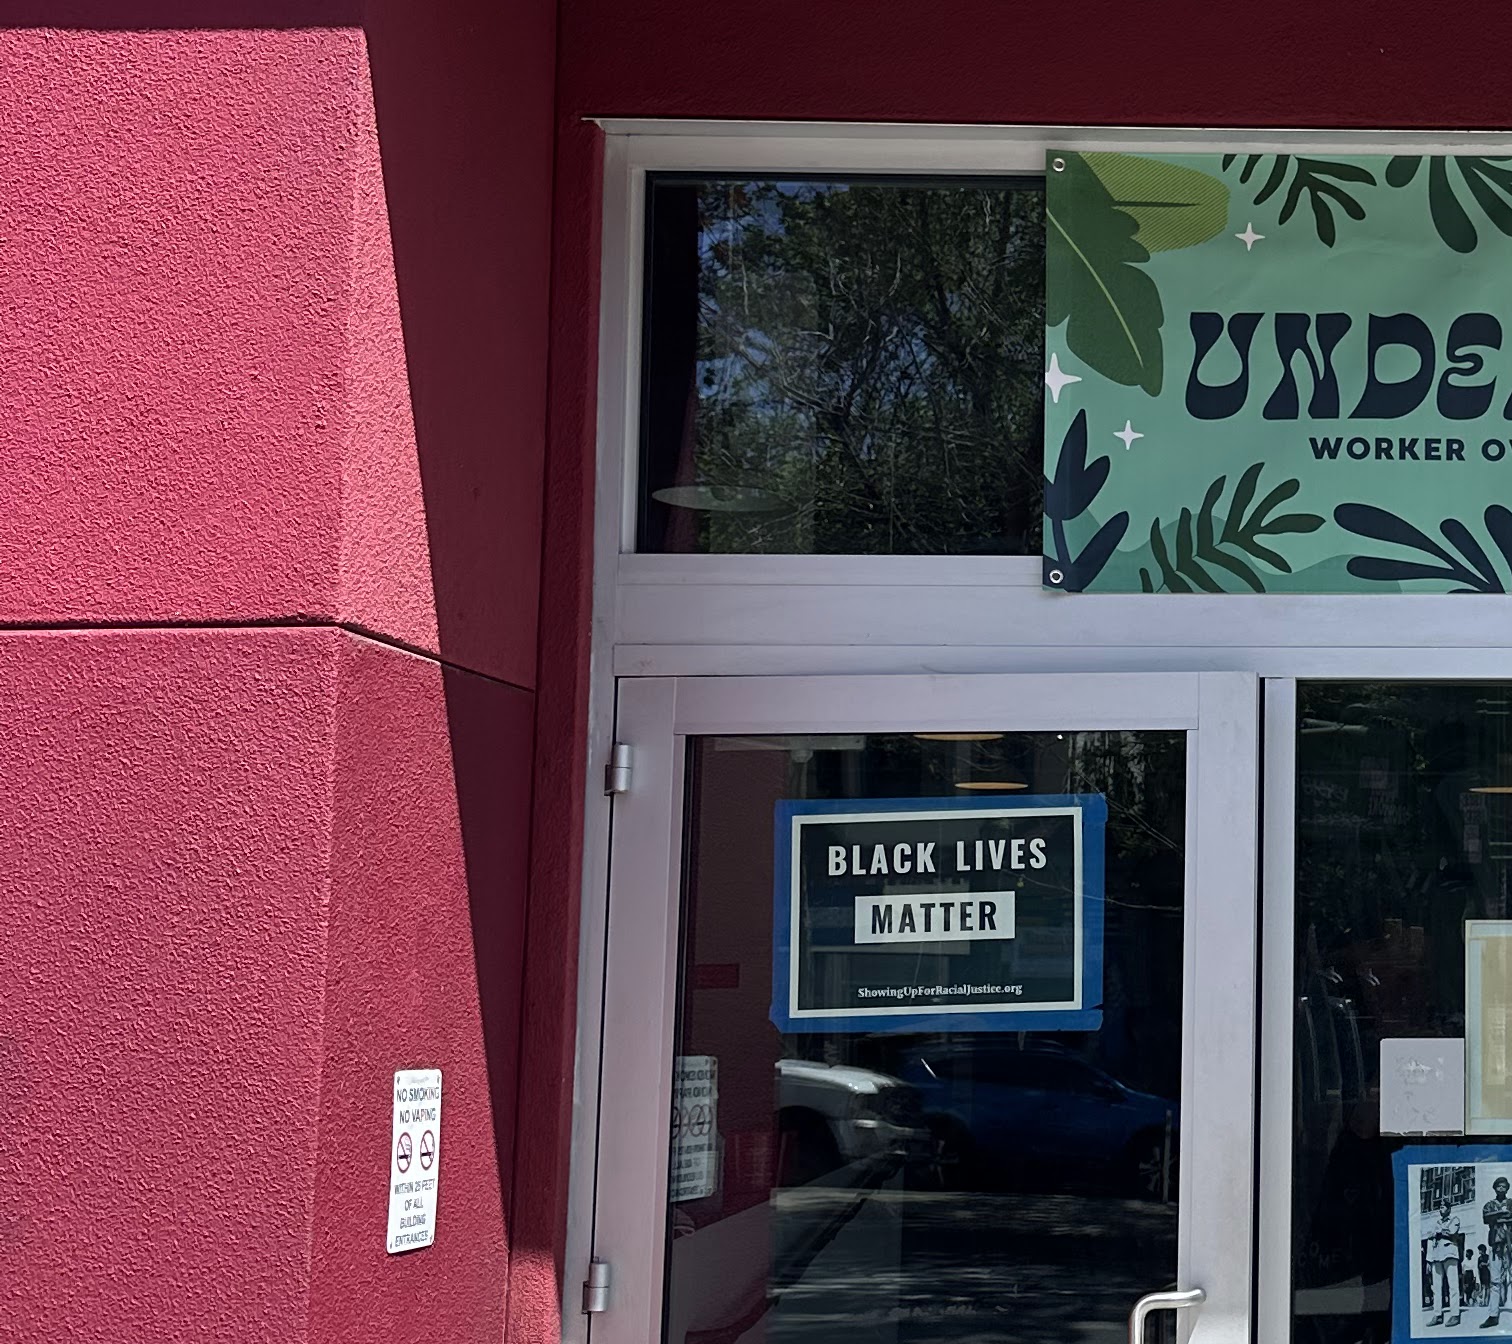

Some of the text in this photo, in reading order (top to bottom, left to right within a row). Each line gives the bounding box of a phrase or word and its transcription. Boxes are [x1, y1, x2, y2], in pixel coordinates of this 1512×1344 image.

[1309, 436, 1466, 462] WORKER
[828, 838, 1047, 876] BLACK LIVES
[871, 900, 997, 935] MATTER
[857, 983, 1023, 999] ShowingUpForRacialJustice.org
[396, 1086, 440, 1103] NO SMOKING
[399, 1107, 437, 1124] NO VAPING
